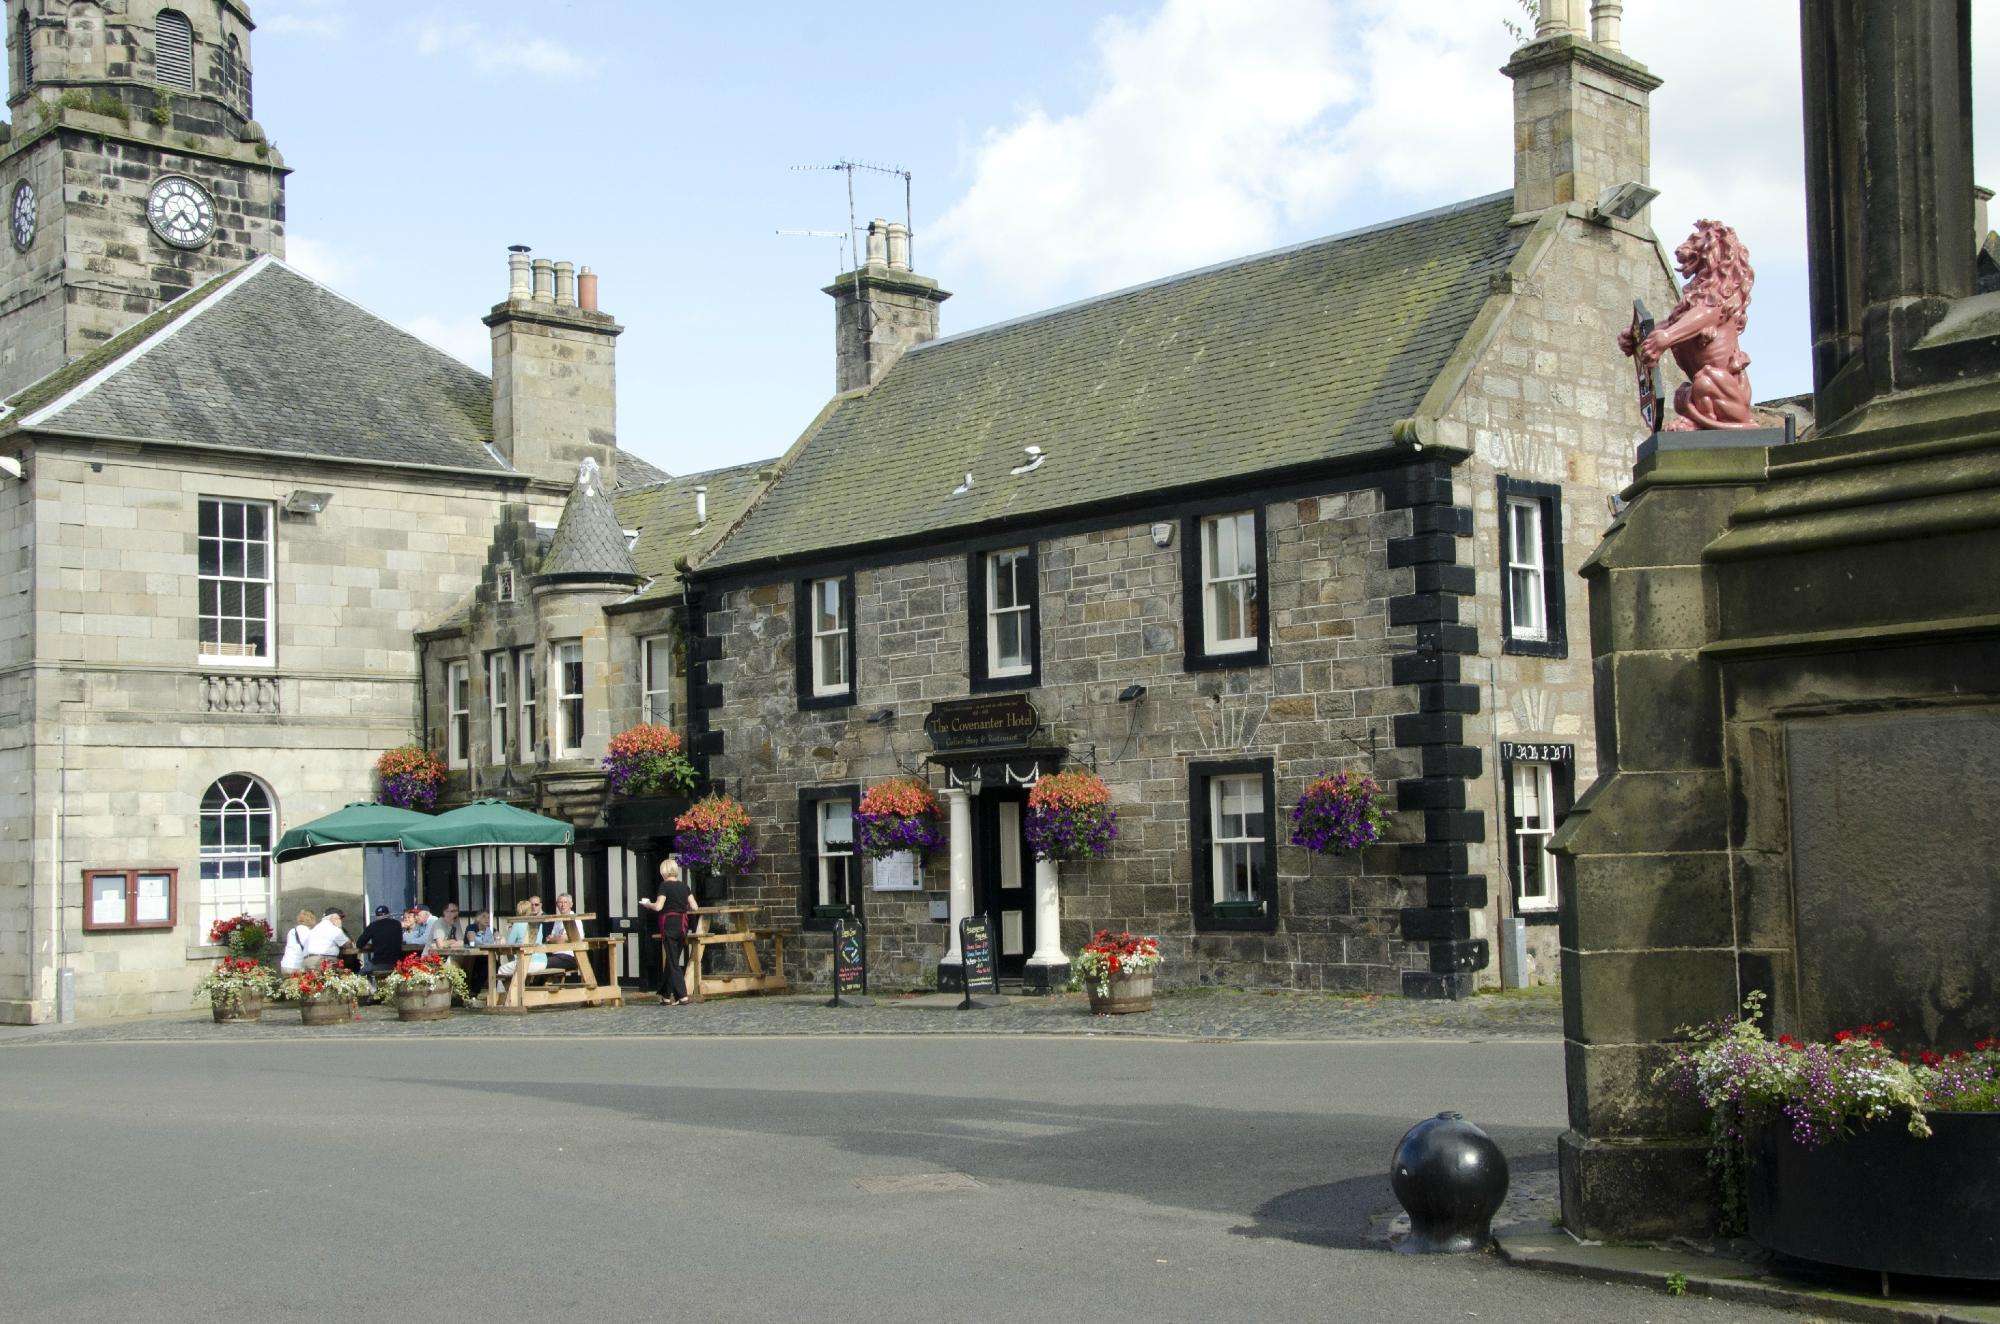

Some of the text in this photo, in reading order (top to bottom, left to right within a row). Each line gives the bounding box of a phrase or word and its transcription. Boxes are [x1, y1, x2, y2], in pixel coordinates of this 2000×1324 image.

[931, 710, 1033, 734] The Covenanter Hotel
